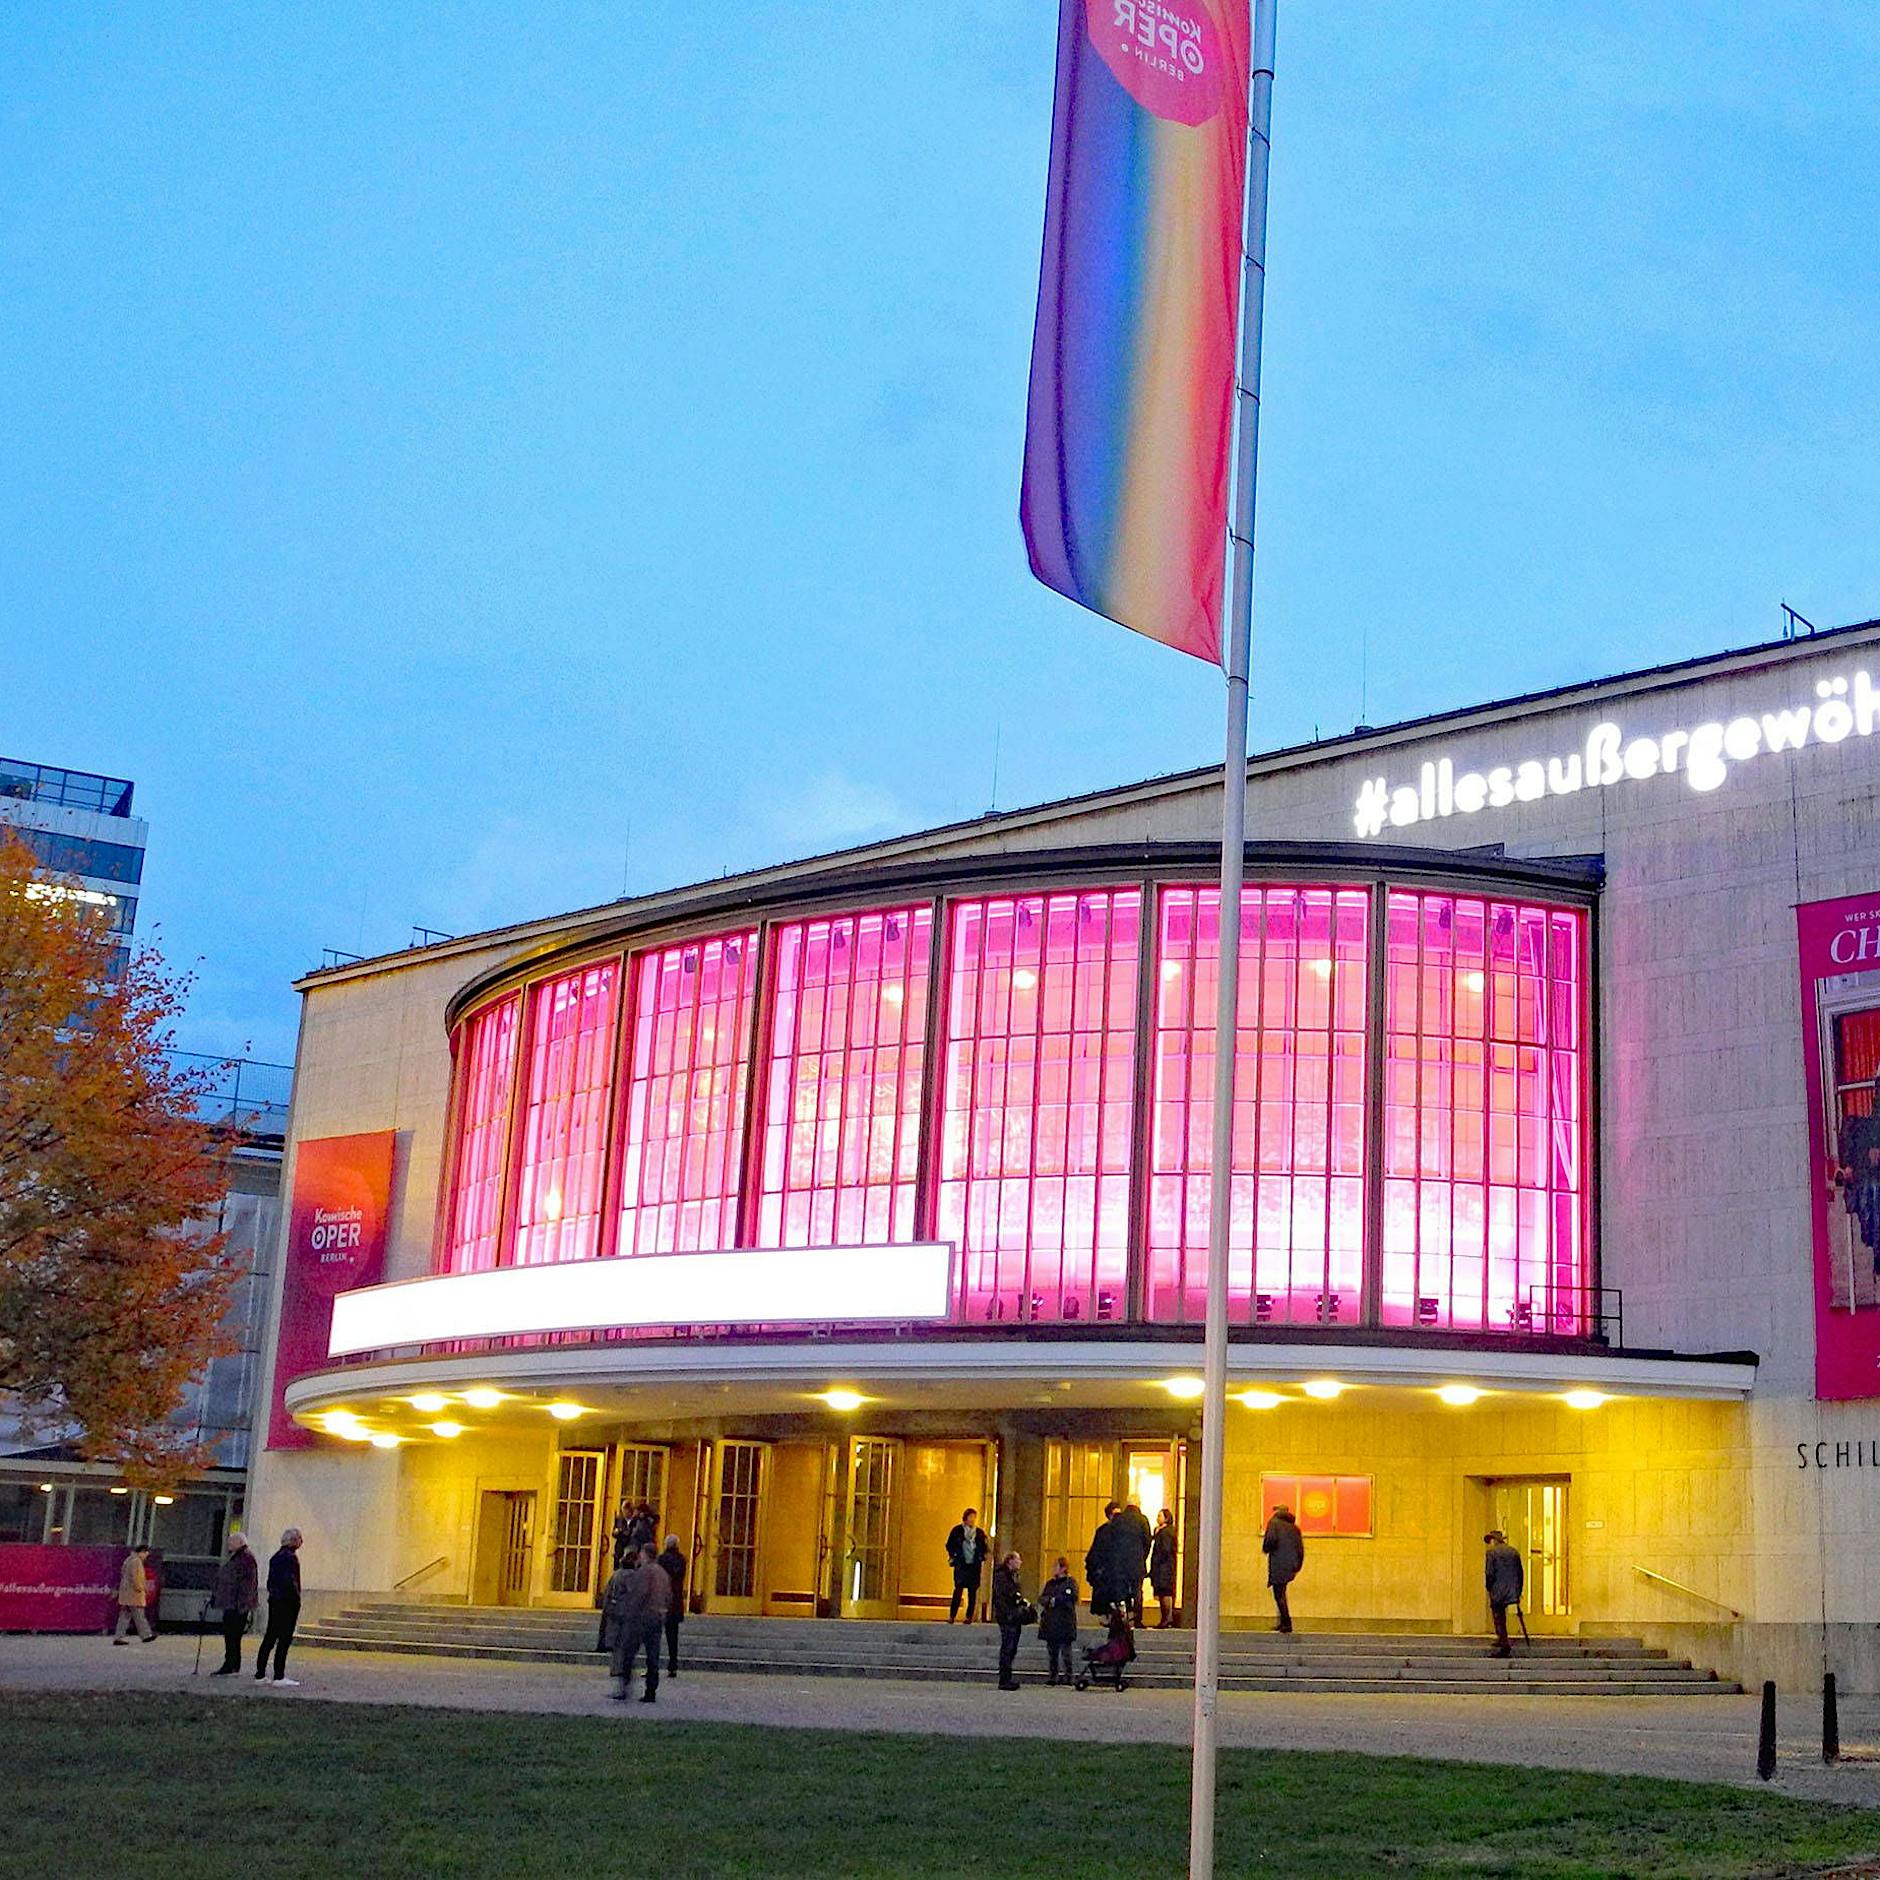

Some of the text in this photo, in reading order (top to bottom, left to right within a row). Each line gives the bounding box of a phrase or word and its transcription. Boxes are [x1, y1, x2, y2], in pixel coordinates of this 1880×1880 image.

[1354, 671, 1880, 838] #allesaußergewöh
[1844, 911, 1867, 922] WER
[1830, 925, 1880, 964] CH
[311, 1223, 361, 1249] OPER
[1797, 1440, 1880, 1469] SCHIL
